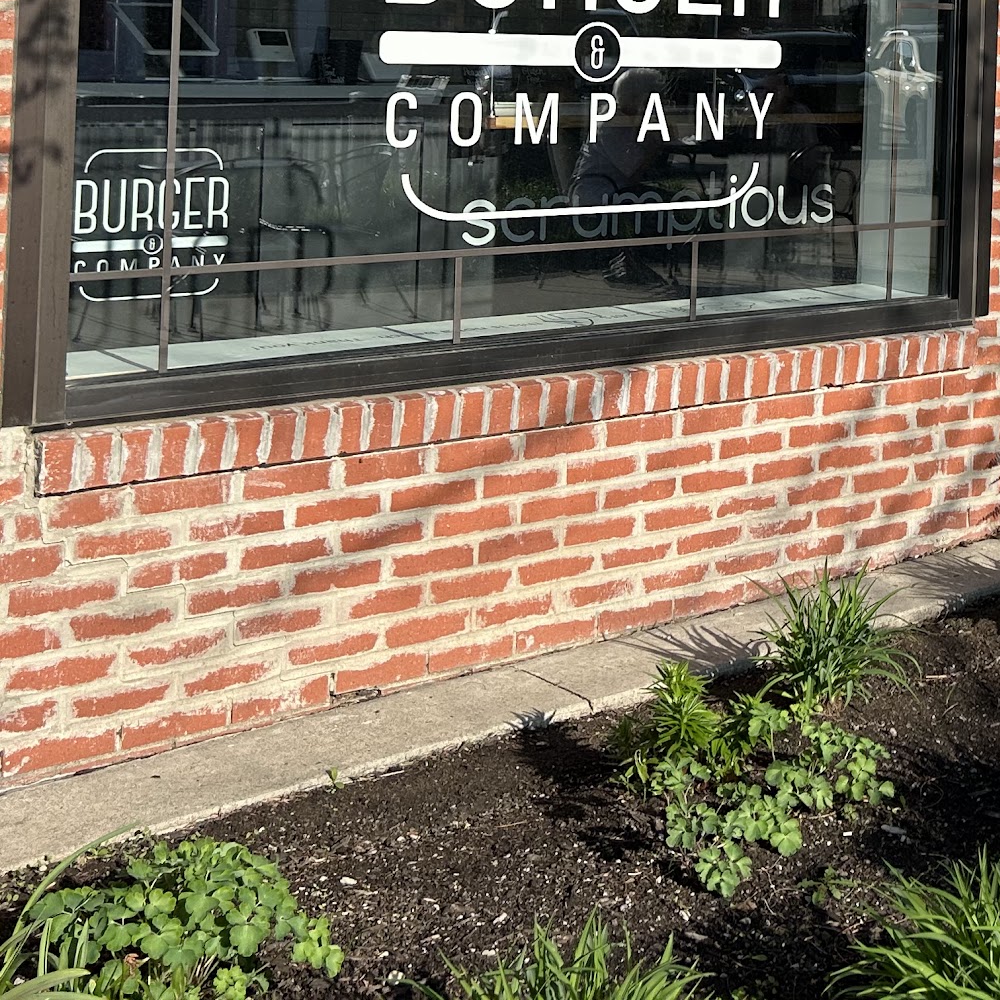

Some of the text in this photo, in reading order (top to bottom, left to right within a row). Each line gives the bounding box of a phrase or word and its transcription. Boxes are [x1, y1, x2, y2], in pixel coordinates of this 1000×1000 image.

[590, 34, 605, 70] &
[385, 90, 775, 149] COMPANY
[73, 176, 230, 234] BURGER
[461, 171, 834, 249] scrumptious
[73, 253, 226, 274] COMPANY
